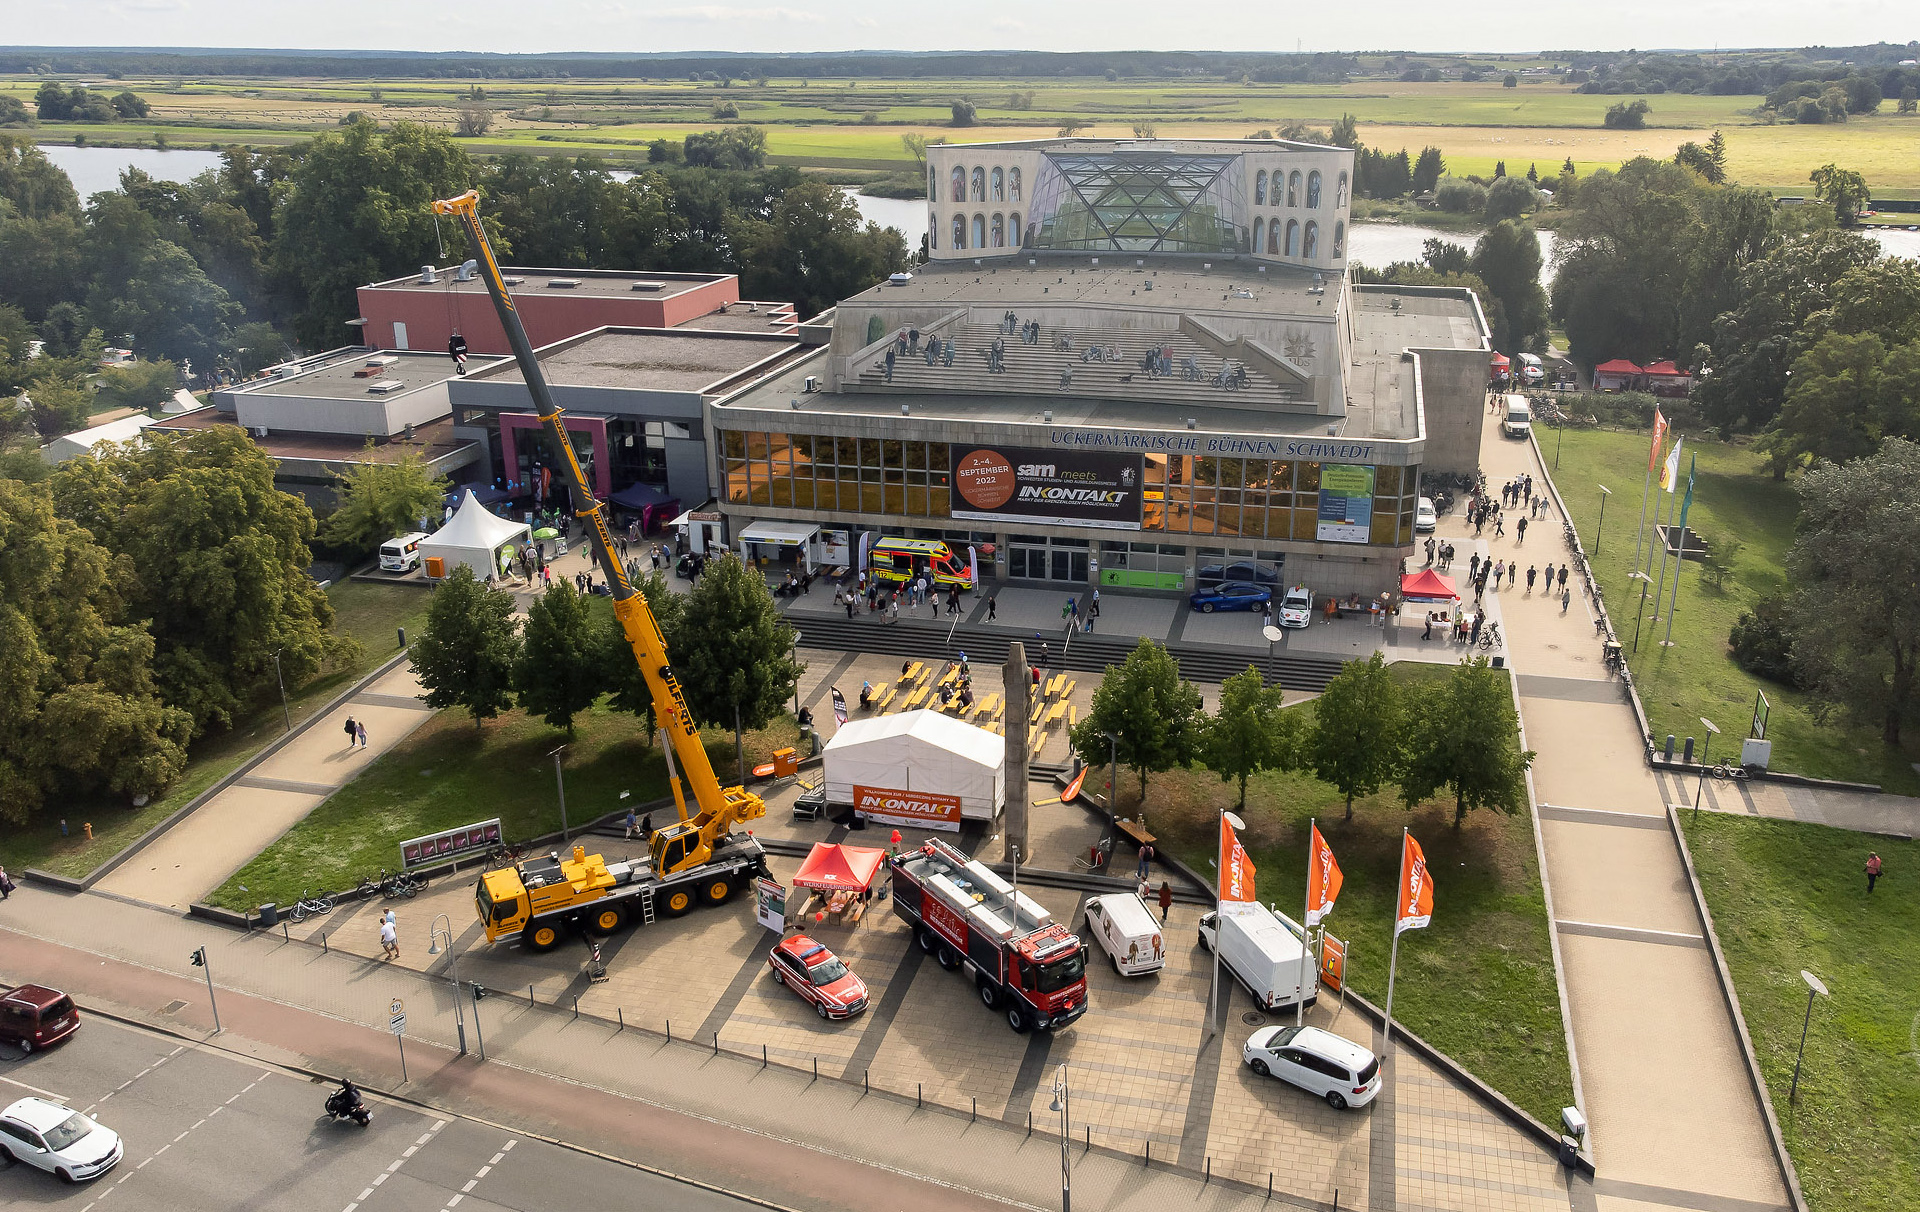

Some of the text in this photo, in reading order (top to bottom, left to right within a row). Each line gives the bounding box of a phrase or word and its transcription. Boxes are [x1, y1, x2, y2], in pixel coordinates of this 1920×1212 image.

[554, 420, 568, 446] ULFERTS
[1051, 432, 1373, 459] UCKERMÄRKISCHE BÜHNEN SCHWEDT
[960, 466, 1010, 477] SEPTEMBER
[976, 476, 996, 484] 2022
[1017, 464, 1098, 480] sam meets
[1019, 486, 1128, 502] INKONTAKT
[594, 514, 611, 547] ULFERTS
[665, 676, 696, 736] ULFERTS
[861, 796, 956, 815] INKONTAKT
